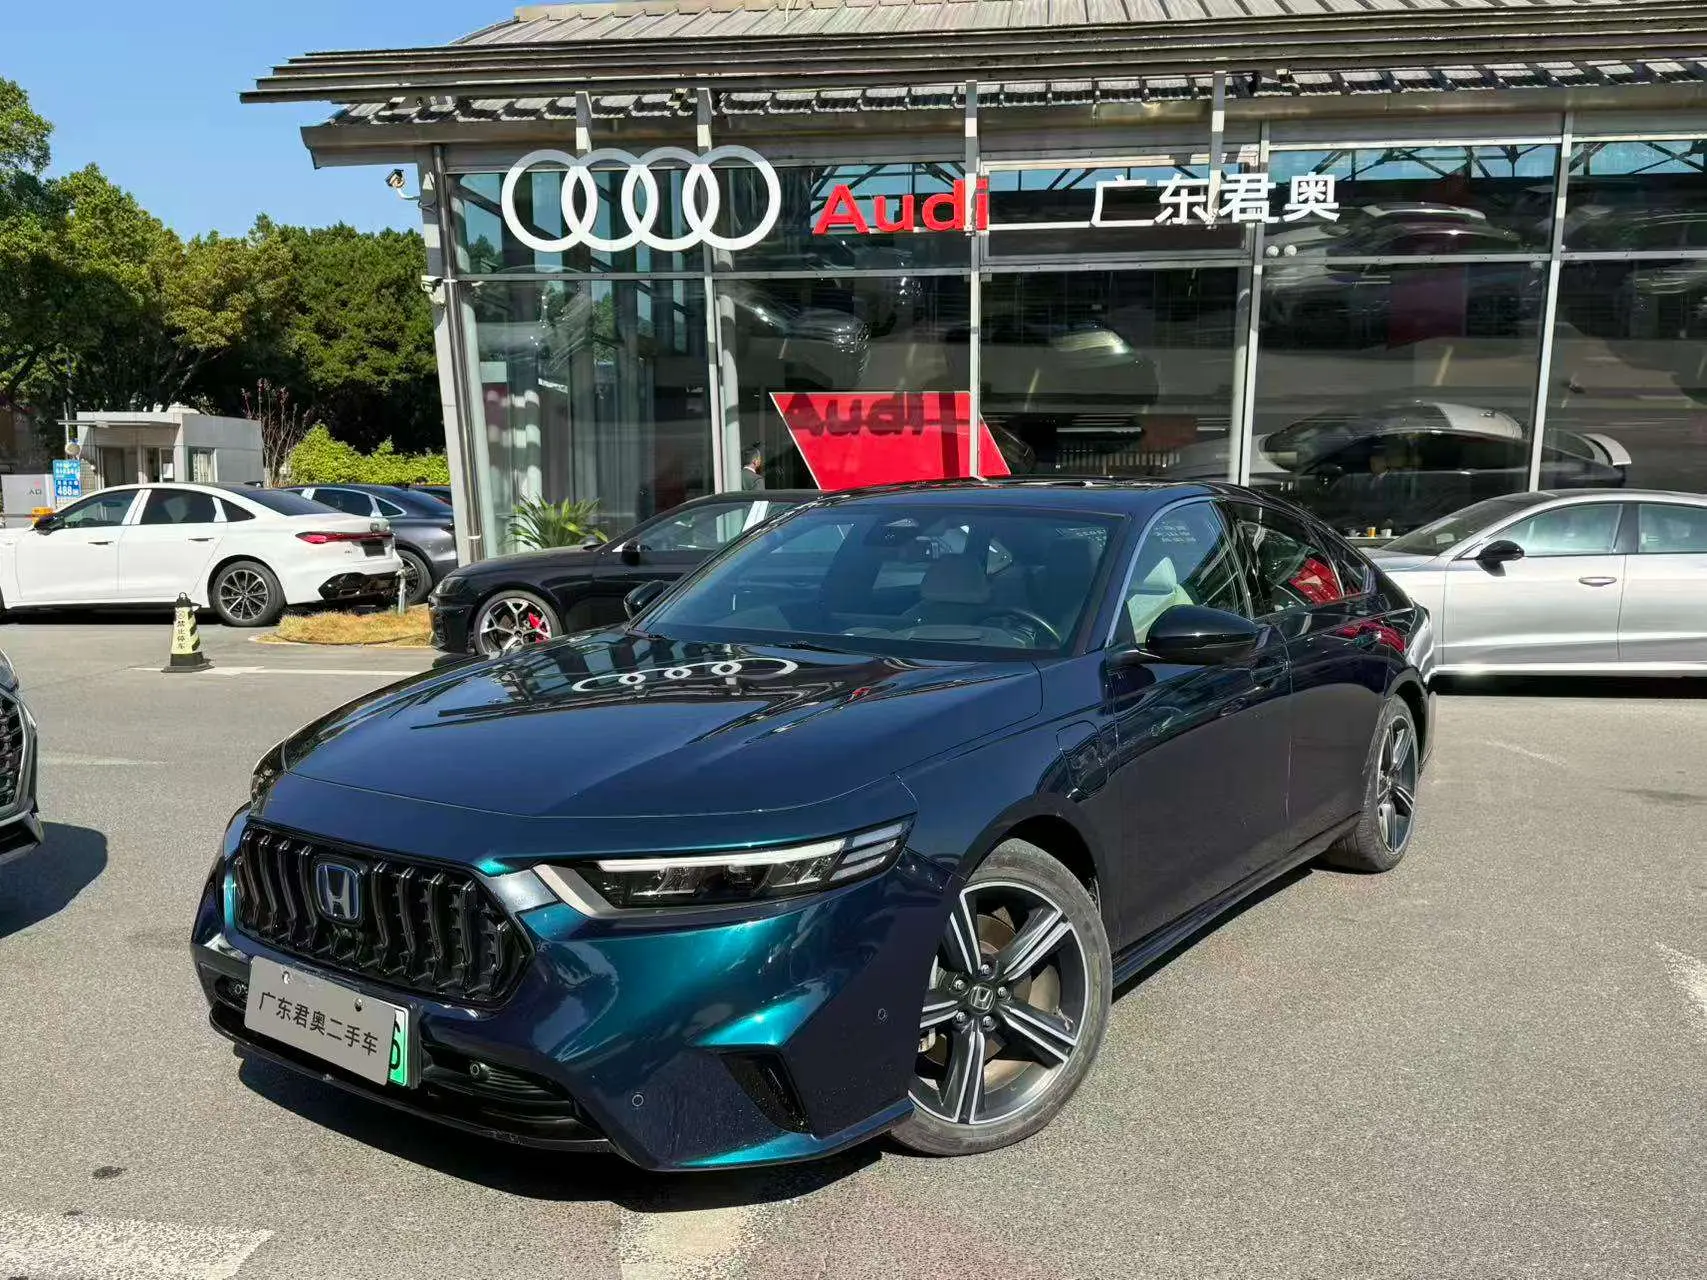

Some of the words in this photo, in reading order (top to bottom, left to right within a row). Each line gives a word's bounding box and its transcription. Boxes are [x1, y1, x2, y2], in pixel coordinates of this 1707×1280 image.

[812, 178, 989, 234] Audi
[1089, 170, 1341, 227] 广东君奥
[258, 991, 379, 1056] 广东君奥二手车
